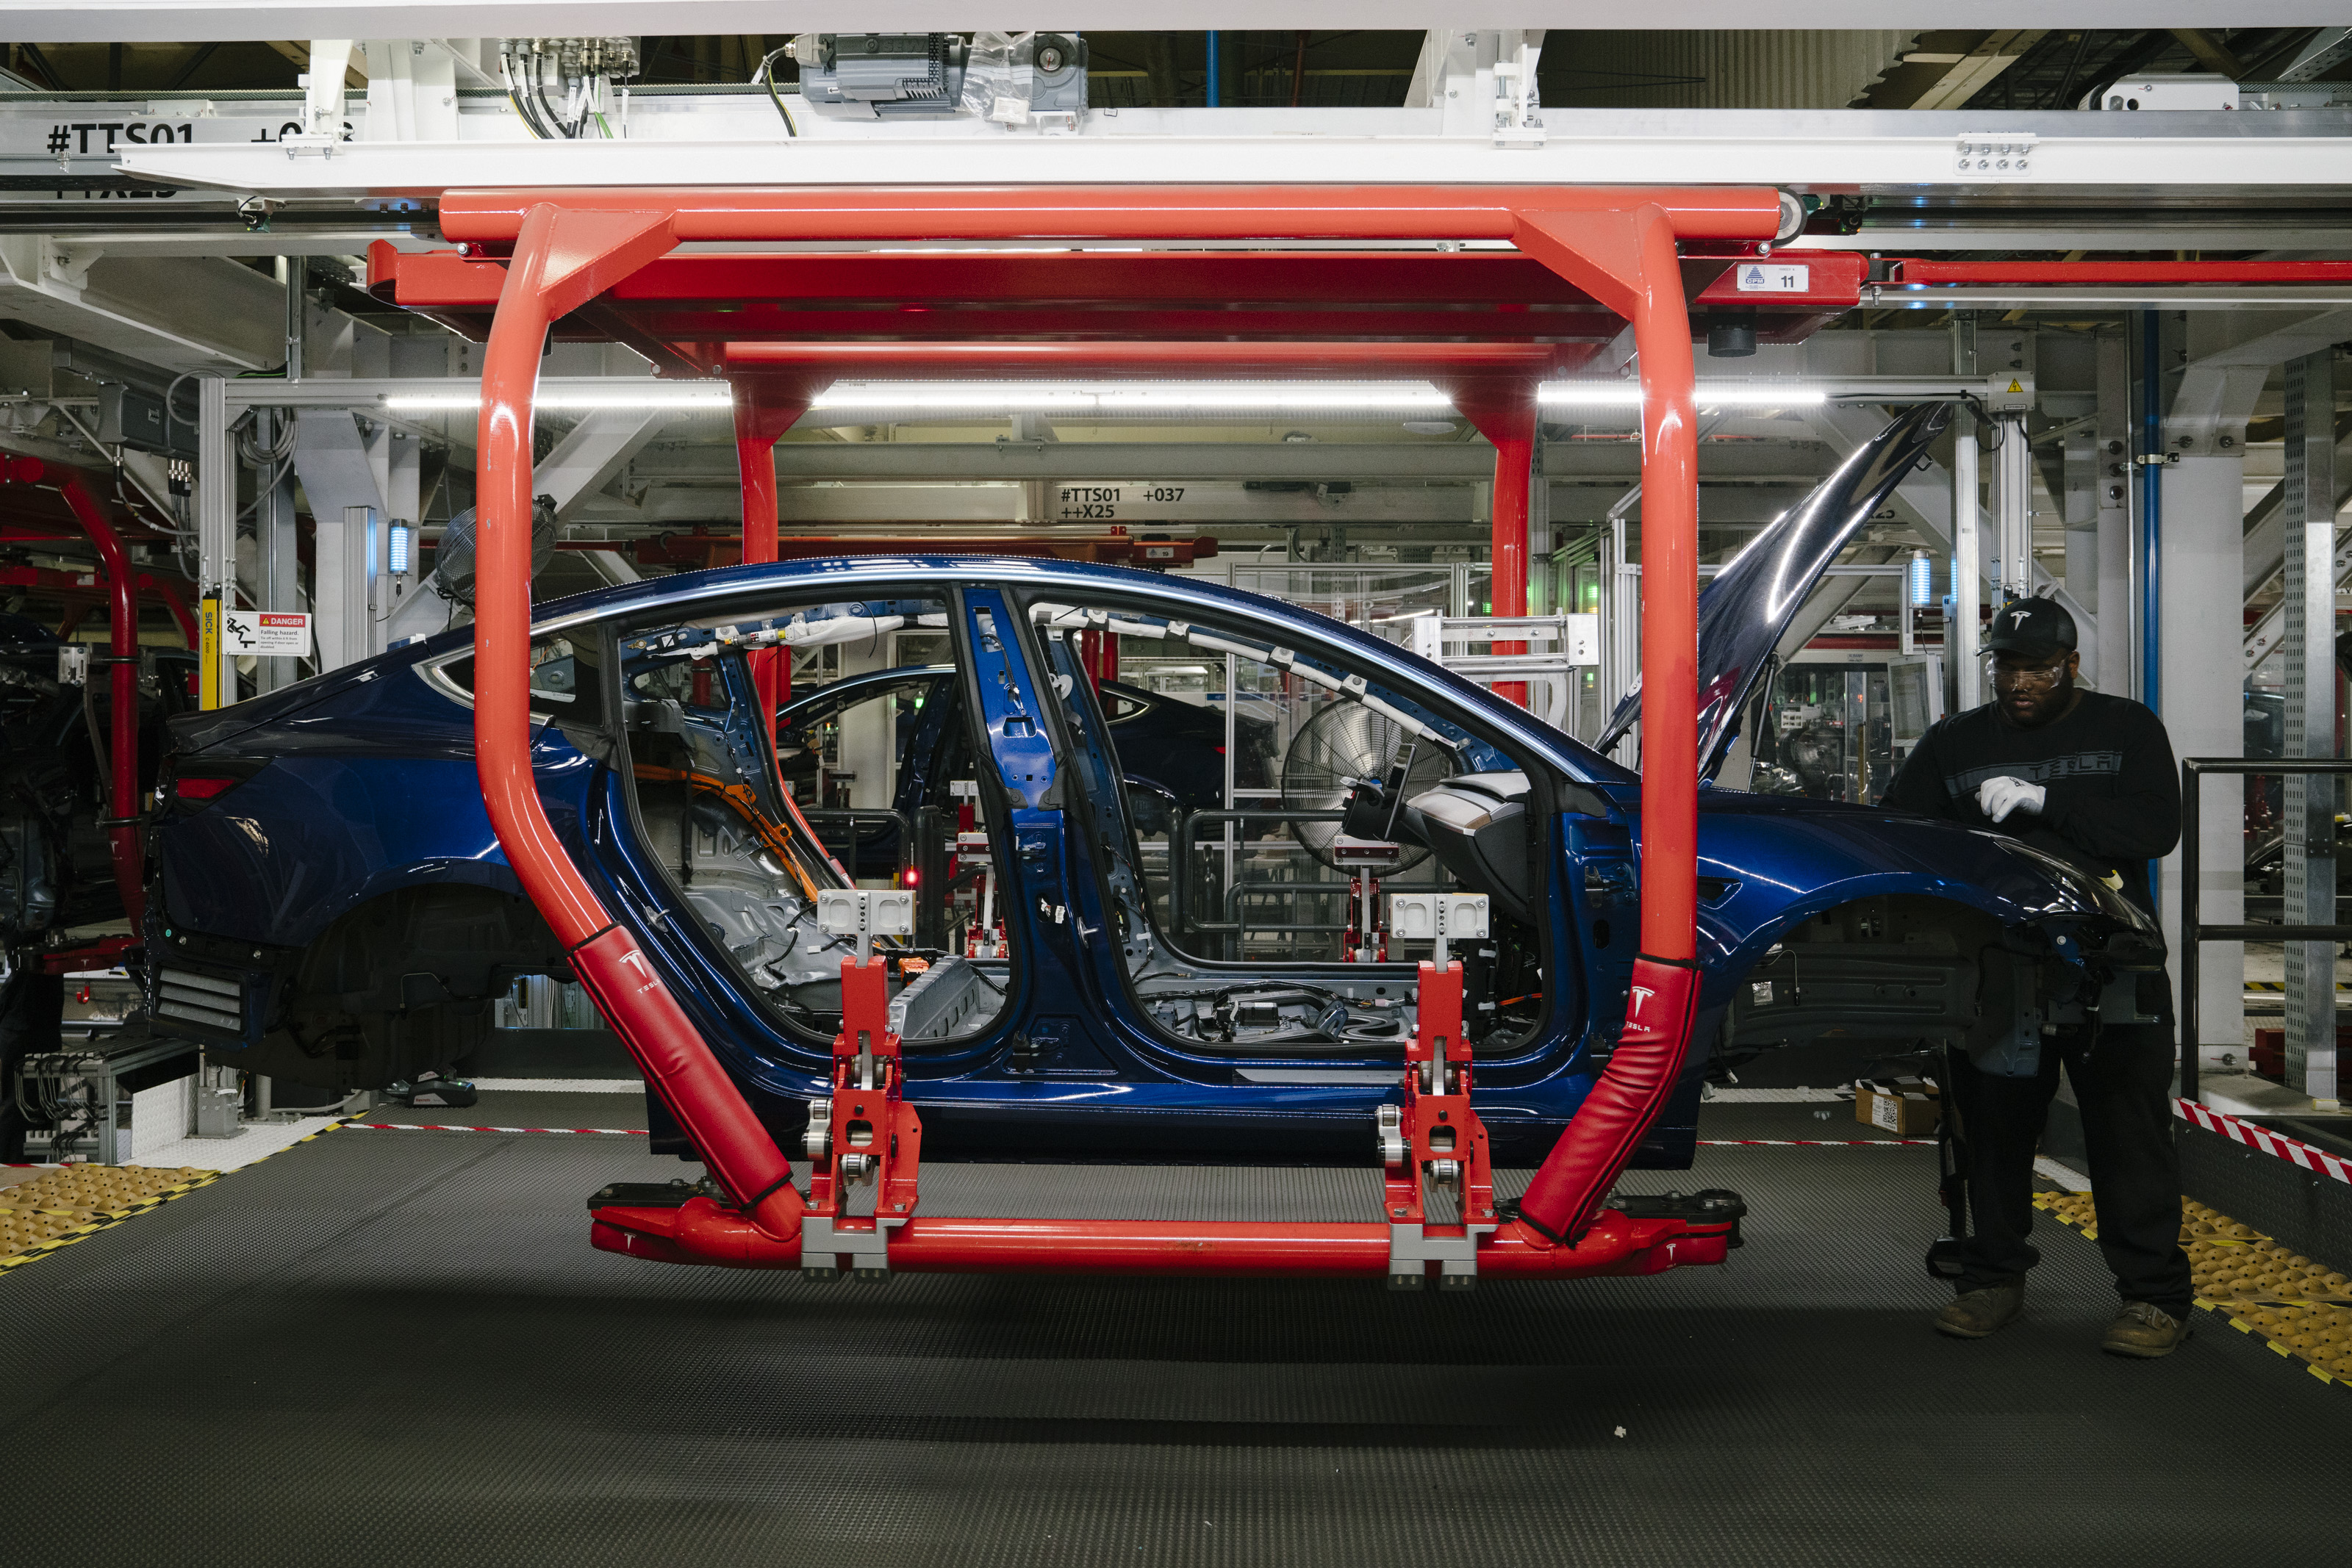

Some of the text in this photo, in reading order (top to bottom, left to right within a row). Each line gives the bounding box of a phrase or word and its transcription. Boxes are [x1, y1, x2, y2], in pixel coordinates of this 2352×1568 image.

[1781, 276, 1793, 287] 11
[1061, 488, 1185, 502] #TTS01 +037
[1061, 504, 1114, 518] ++X25
[205, 611, 213, 634] SICK
[270, 617, 303, 625] DANGER
[637, 979, 661, 994] TESLA
[1626, 1021, 1651, 1032] TESLA
